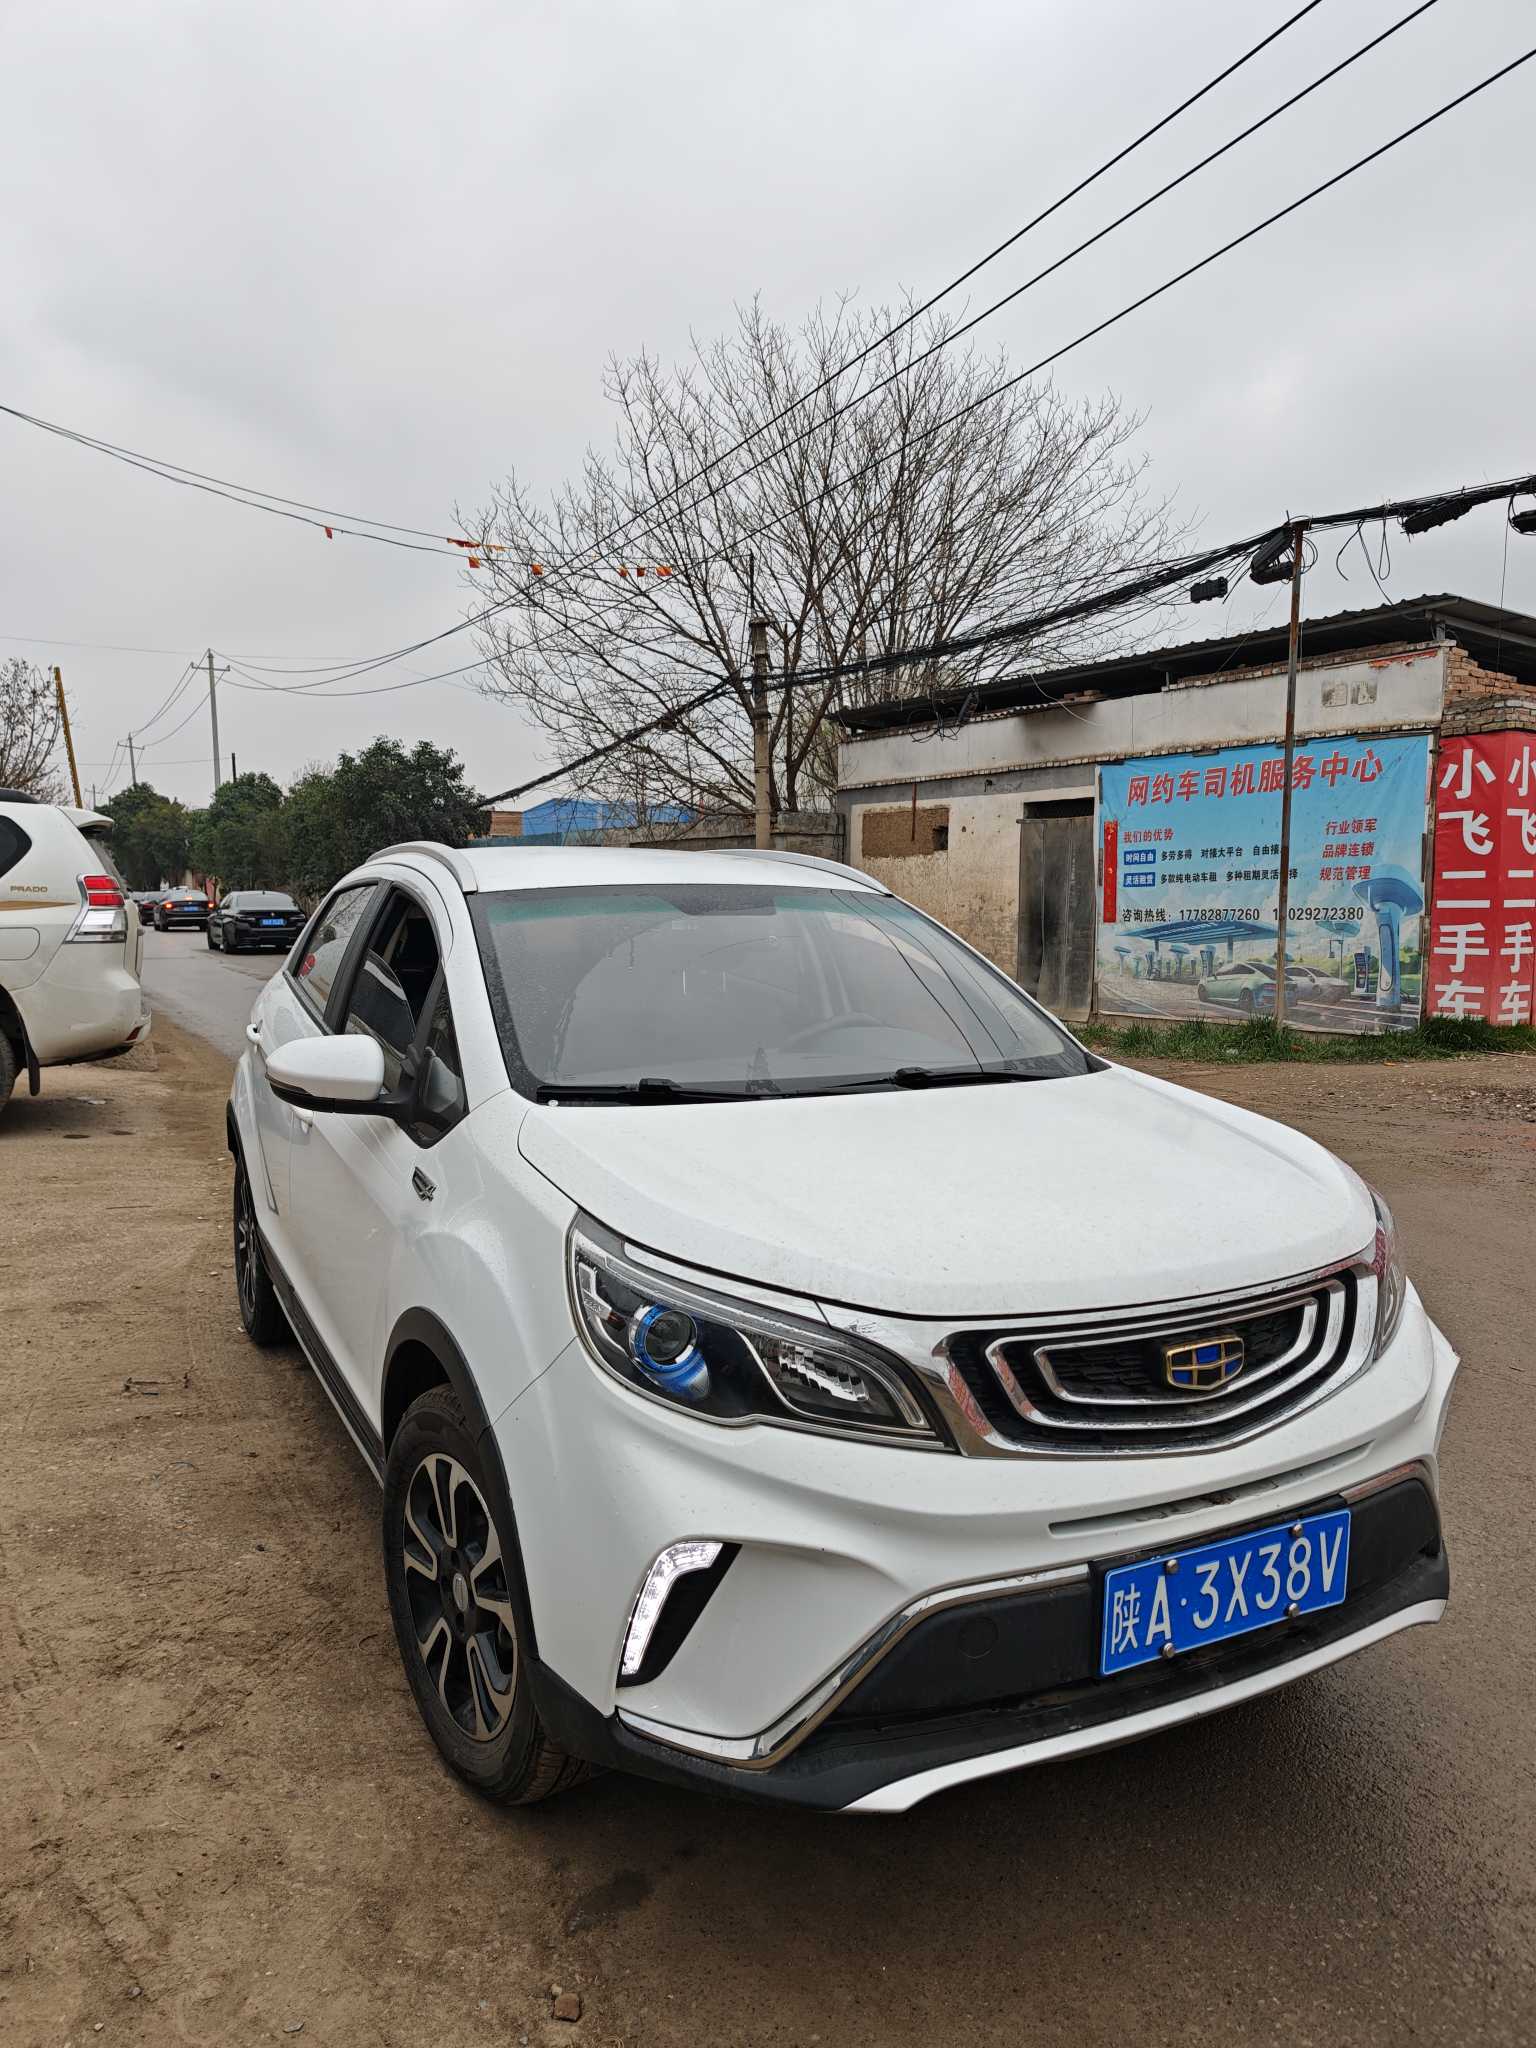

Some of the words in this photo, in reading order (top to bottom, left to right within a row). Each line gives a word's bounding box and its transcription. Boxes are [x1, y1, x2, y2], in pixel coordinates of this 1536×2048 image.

[1127, 748, 1384, 807] 网约车司机服务中心
[1325, 818, 1377, 835] 行业领军
[1123, 828, 1174, 844] 我们的优势
[1253, 844, 1282, 856] 自由接
[1322, 841, 1375, 858] 品牌连锁
[1226, 868, 1299, 881] 多种租期灵活择
[1319, 865, 1371, 881] 规范管理
[1433, 748, 1497, 1020] 小飞二手车
[1497, 745, 1536, 1026] 小飞二手车
[1180, 908, 1260, 922] 17782877260
[1272, 907, 1364, 921] 1029272380
